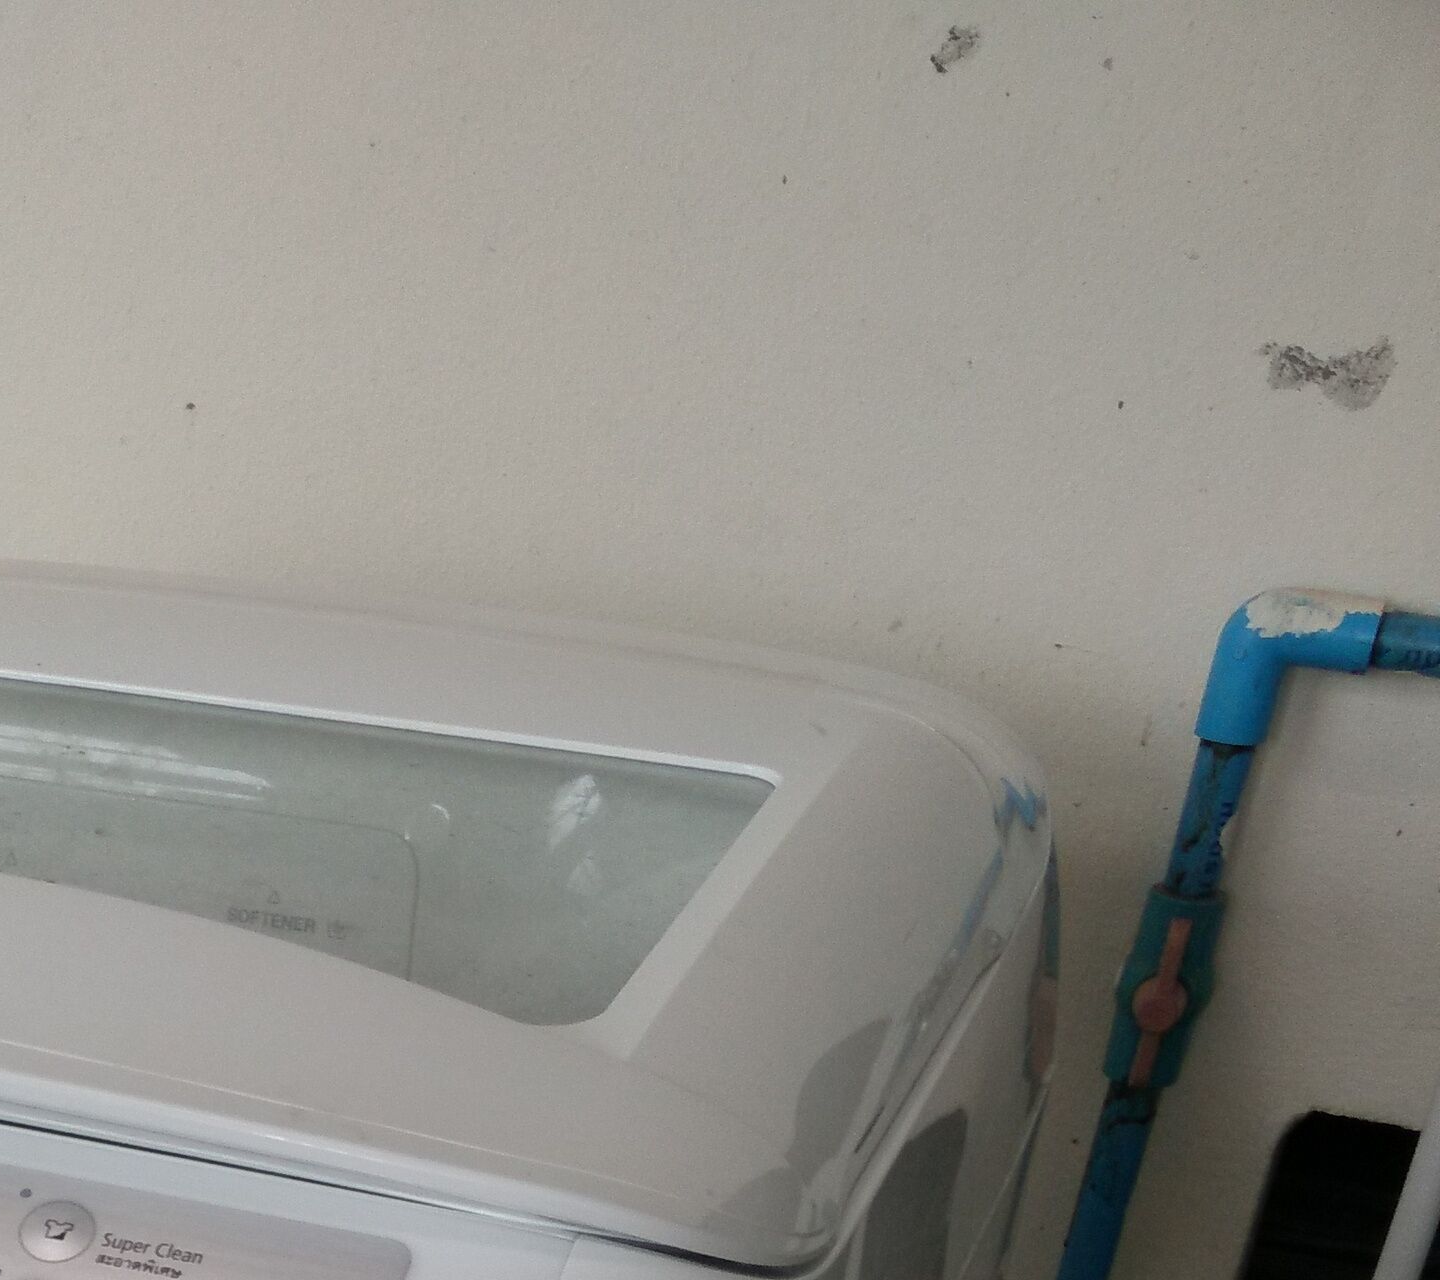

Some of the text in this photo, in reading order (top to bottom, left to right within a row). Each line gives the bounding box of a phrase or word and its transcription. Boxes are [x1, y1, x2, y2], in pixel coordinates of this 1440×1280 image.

[101, 1232, 203, 1265] Super Clean
[95, 1252, 183, 1280] สะอาดพิเศษ
